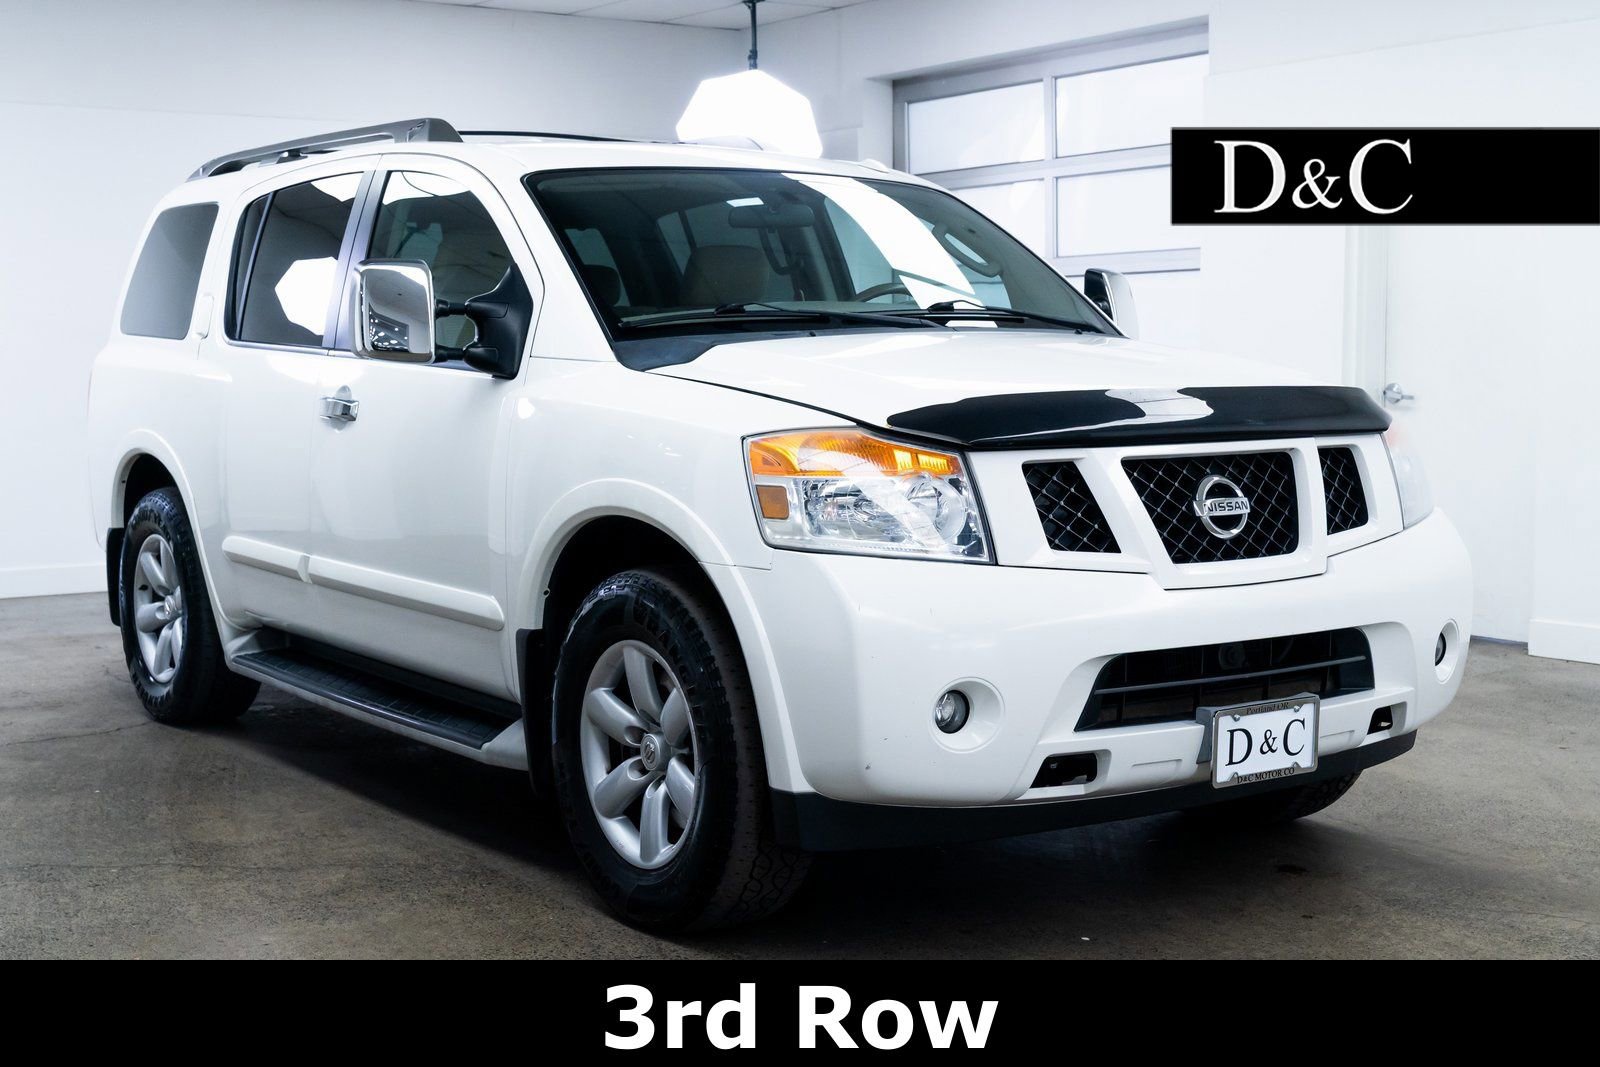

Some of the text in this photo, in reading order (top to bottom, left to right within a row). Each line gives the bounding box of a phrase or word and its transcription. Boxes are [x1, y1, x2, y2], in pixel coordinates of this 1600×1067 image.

[1204, 501, 1249, 512] NISSAN
[1246, 702, 1289, 715] Portland OR
[1255, 769, 1282, 781] MOTOR
[1283, 767, 1295, 776] CO
